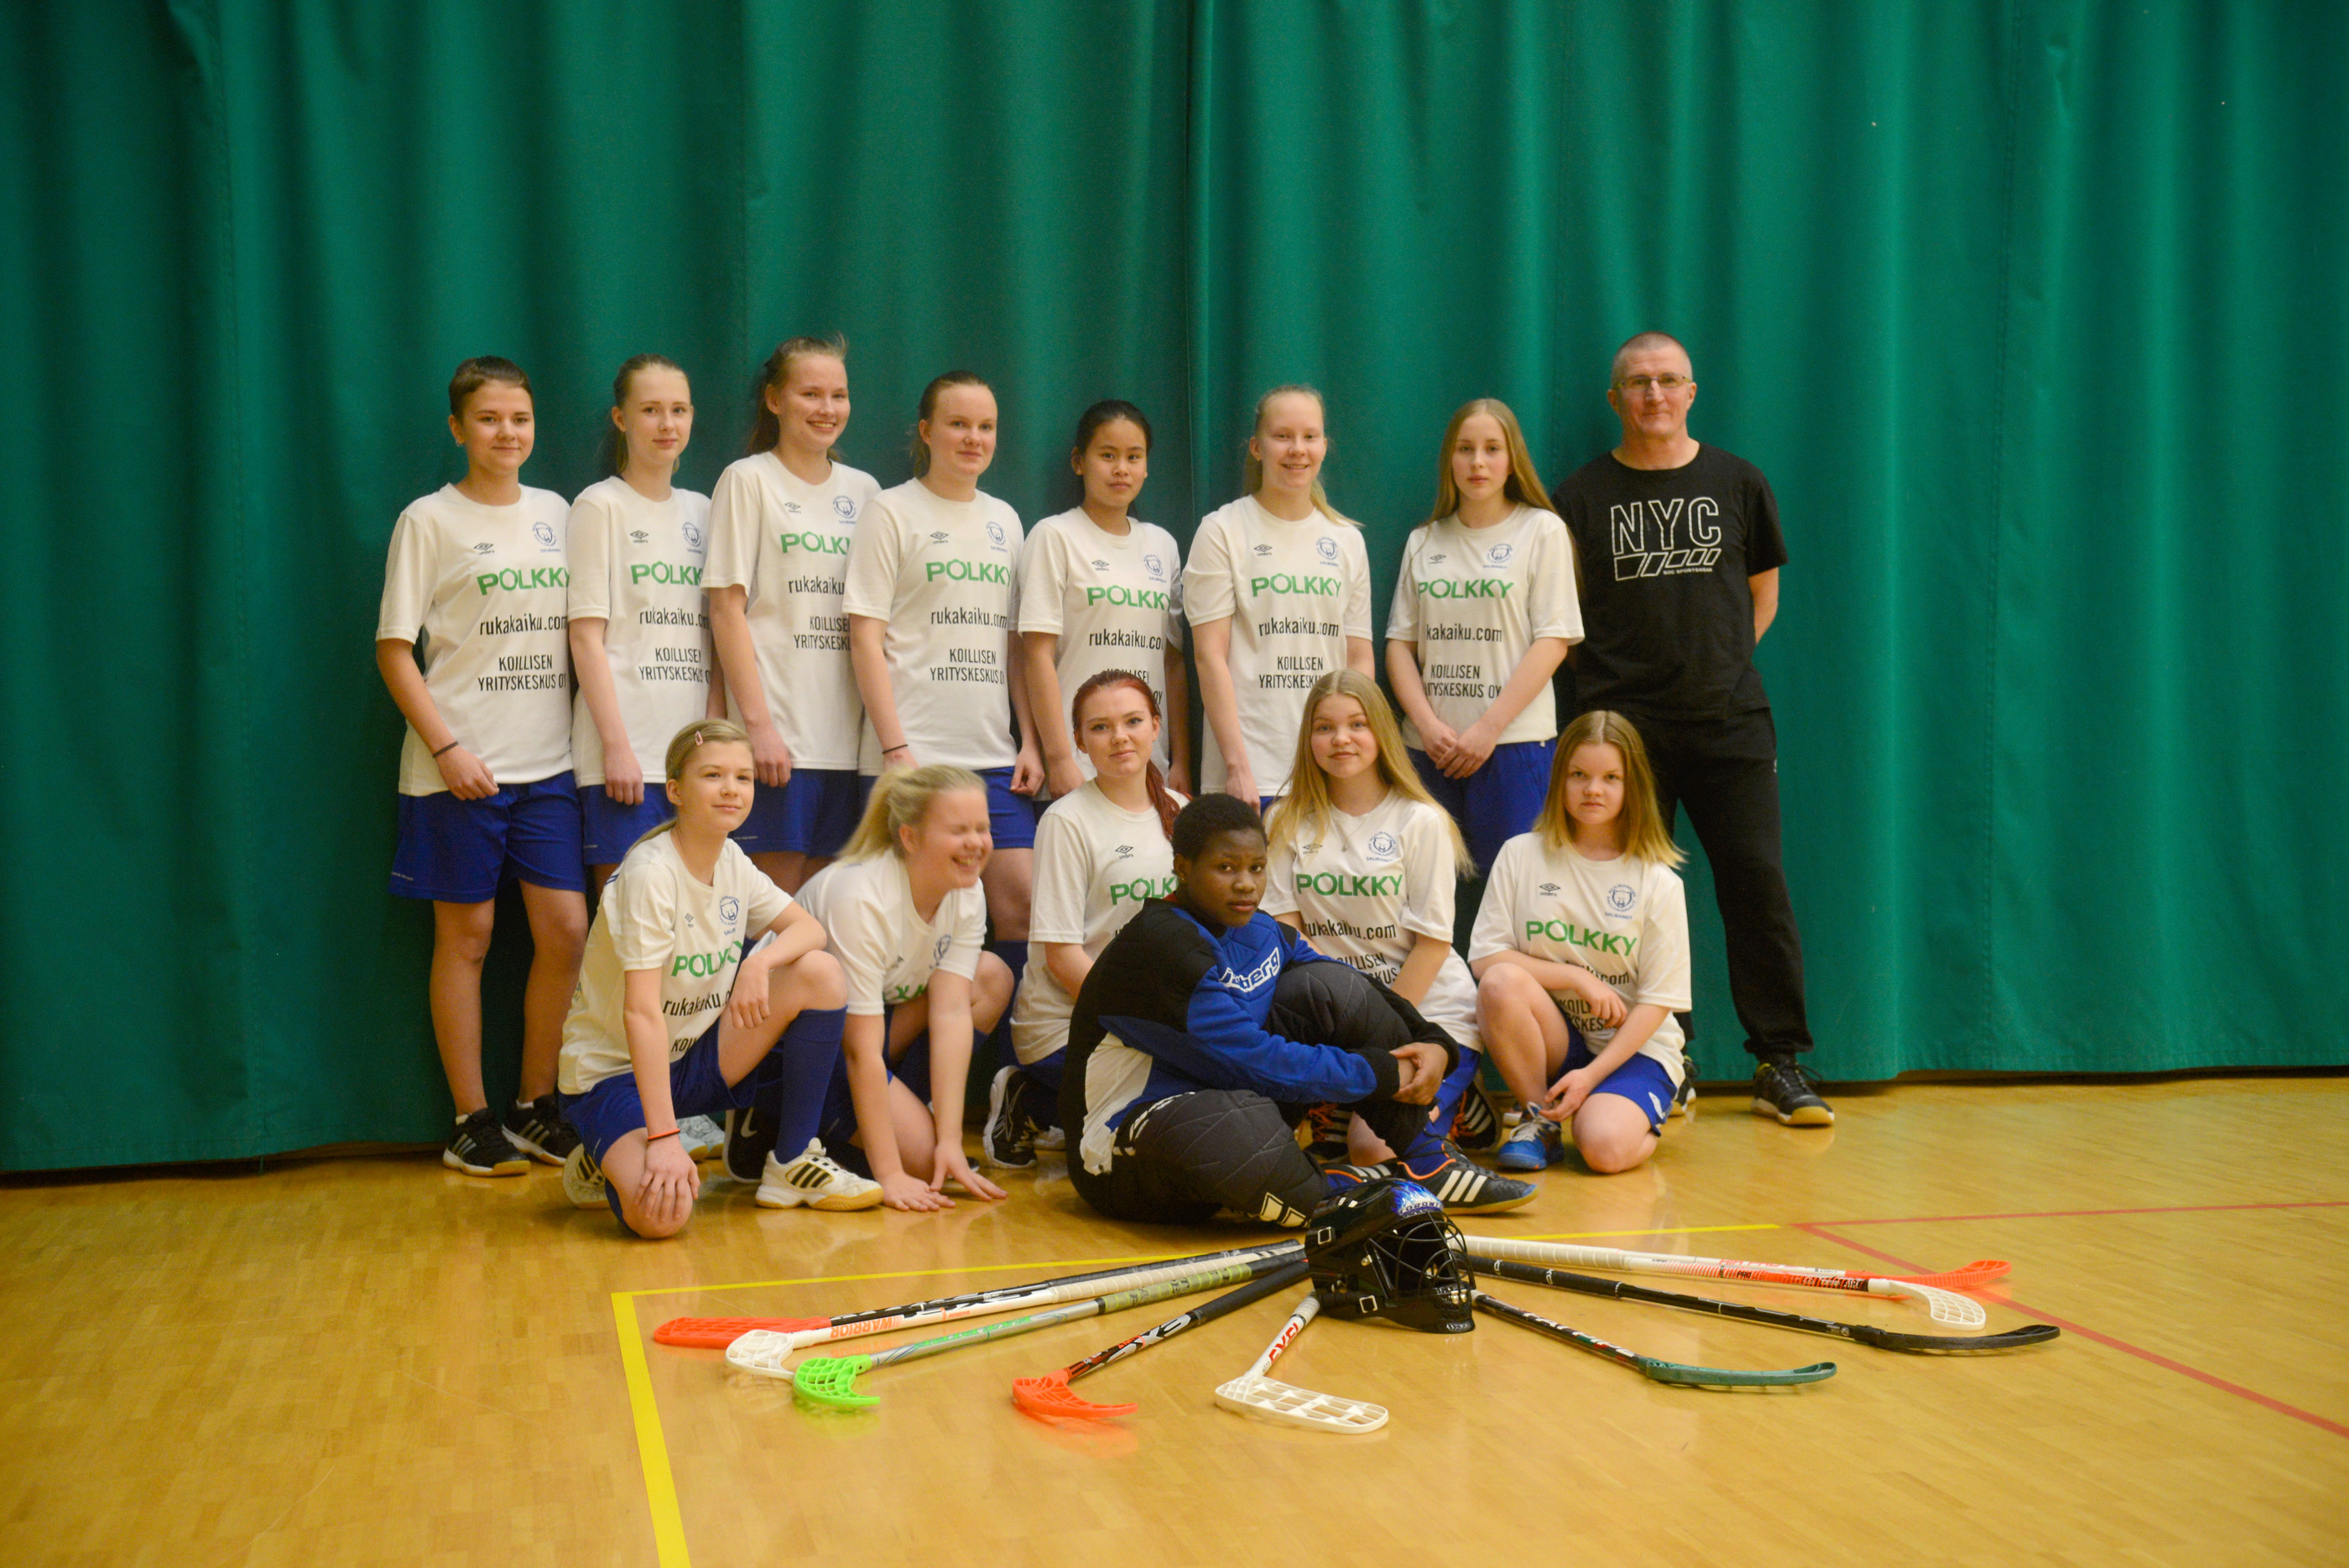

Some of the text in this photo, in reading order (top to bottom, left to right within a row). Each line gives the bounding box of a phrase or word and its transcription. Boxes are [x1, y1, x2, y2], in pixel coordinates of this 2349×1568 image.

[1611, 497, 1721, 555] NYC
[498, 654, 553, 671] KOILLISEN
[949, 648, 996, 664] KOILLISEN
[930, 667, 999, 684] YRITYSKESKUS
[1431, 664, 1480, 680] KOILLISEN
[478, 674, 556, 691] YRITYSKESKUS
[830, 1315, 893, 1339] WARRIOR
